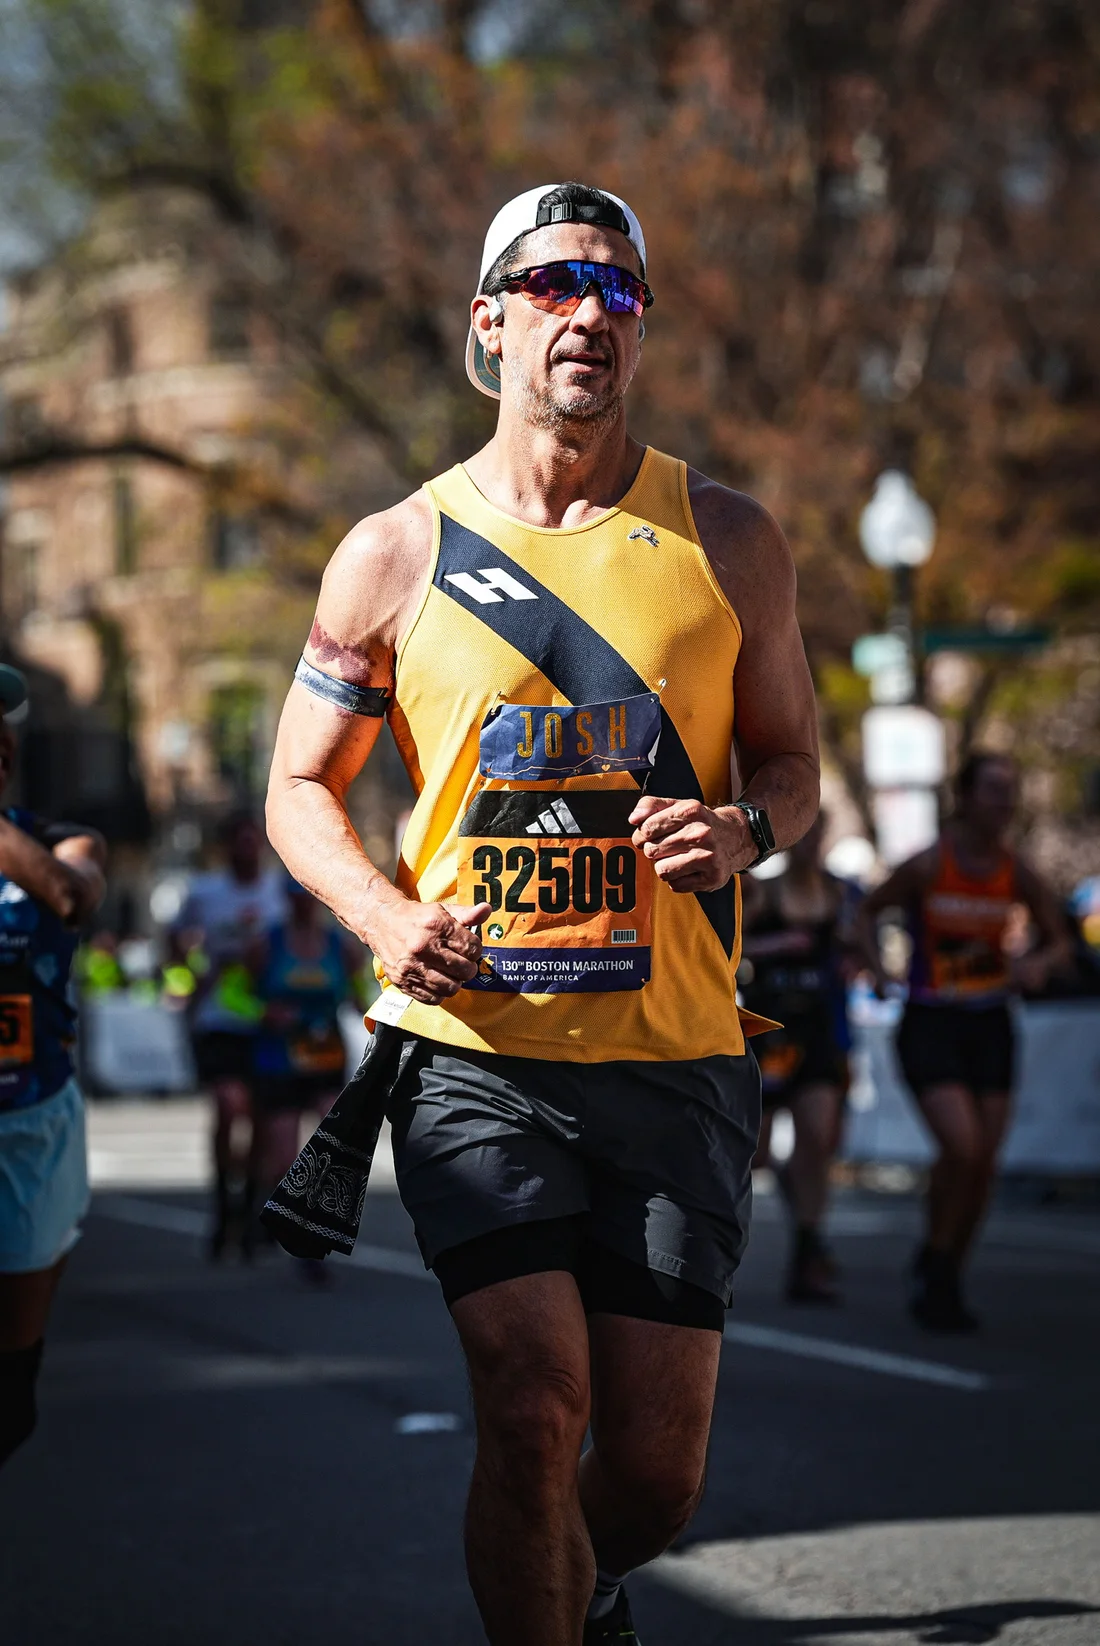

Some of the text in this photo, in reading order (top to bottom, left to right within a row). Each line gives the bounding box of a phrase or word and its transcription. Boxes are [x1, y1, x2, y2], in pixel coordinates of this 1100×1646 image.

[517, 705, 627, 759] JOSH
[472, 845, 637, 914] 32509
[525, 960, 570, 972] BOSTON
[573, 959, 634, 972] MARATHON
